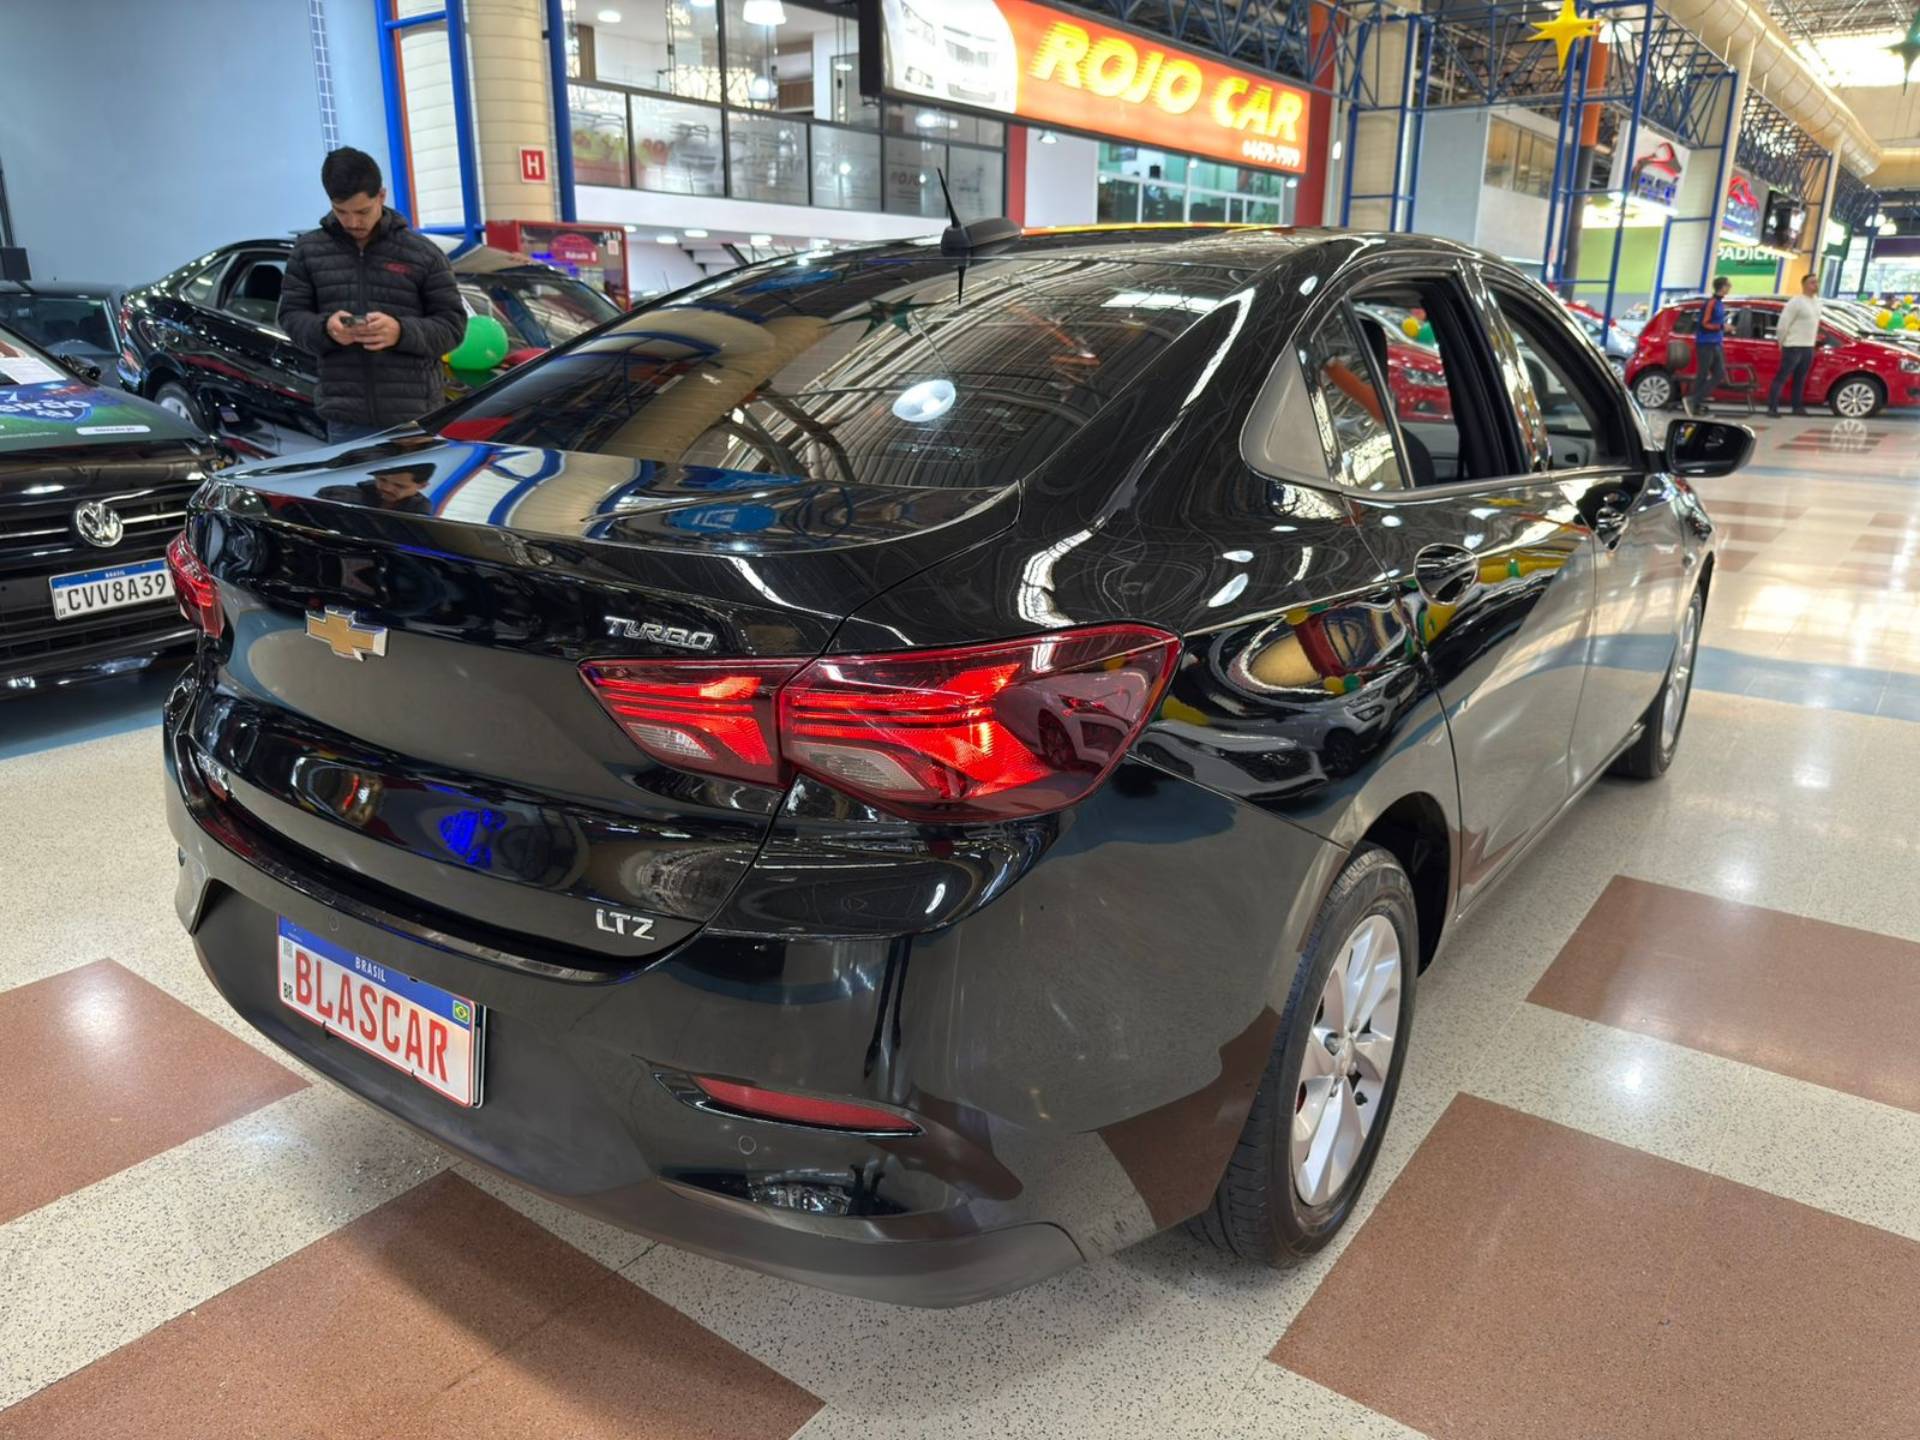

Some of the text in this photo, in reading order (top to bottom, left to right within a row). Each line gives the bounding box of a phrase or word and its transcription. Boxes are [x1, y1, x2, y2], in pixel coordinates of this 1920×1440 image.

[1030, 21, 1303, 142] ROJO CAR
[526, 154, 541, 176] H
[67, 573, 166, 611] CVV8A39
[604, 616, 716, 650] TURBO
[596, 908, 655, 941] LTZ
[355, 956, 386, 983] BRASIL
[283, 982, 294, 1001] BR
[295, 951, 448, 1083] BLASCAR
